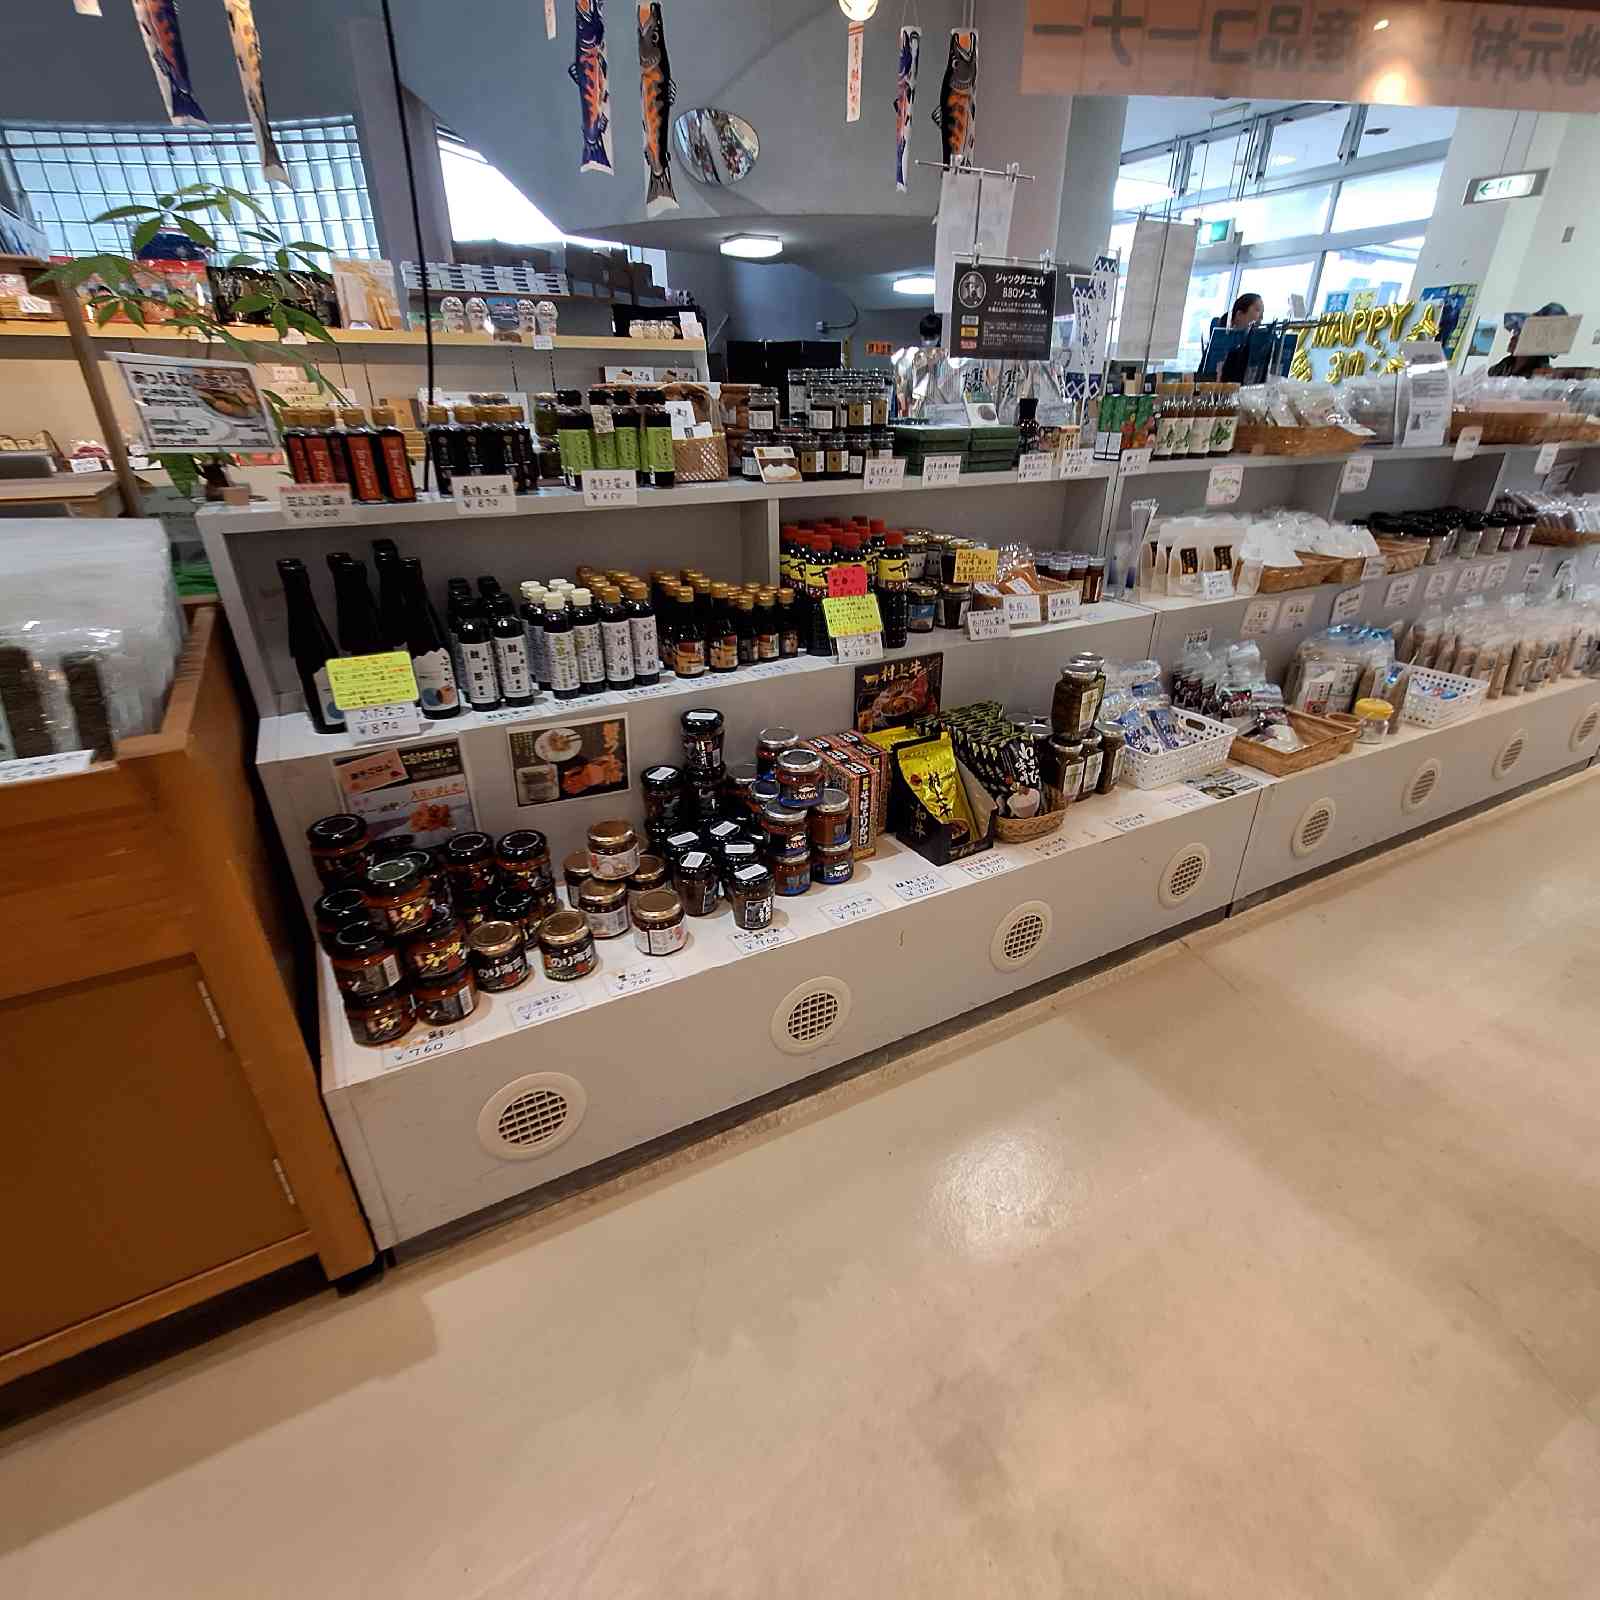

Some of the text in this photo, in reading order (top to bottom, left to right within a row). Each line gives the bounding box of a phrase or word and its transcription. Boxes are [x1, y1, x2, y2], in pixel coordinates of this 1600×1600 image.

[995, 273, 1046, 287] ジャックダニエル
[1003, 287, 1038, 299] BBQソース
[1312, 301, 1415, 348] HAPPY
[881, 656, 923, 682] 村上牛
[356, 721, 399, 735] ¥870
[394, 1043, 443, 1061] ¥760
